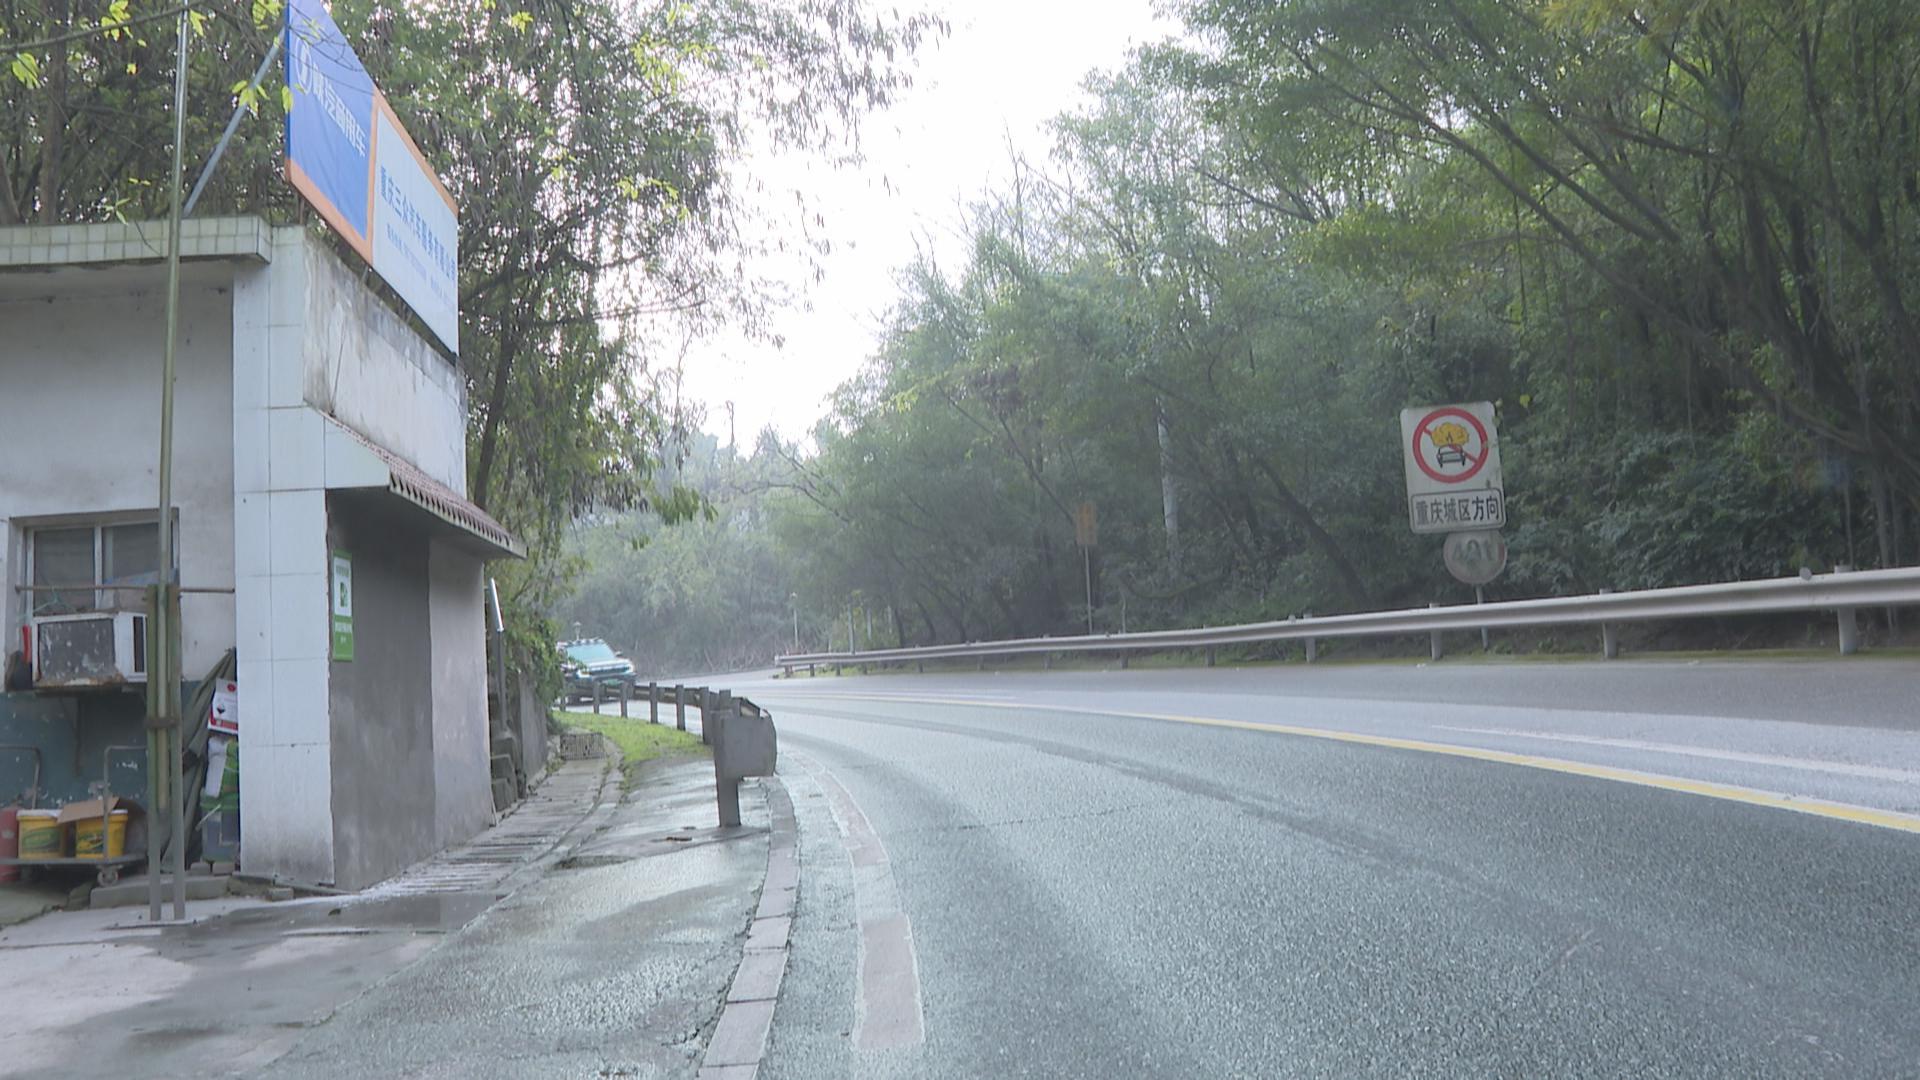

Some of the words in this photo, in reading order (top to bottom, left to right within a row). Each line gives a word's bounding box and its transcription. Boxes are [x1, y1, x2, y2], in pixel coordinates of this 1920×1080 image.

[1415, 496, 1499, 525] 重庆城区方向
